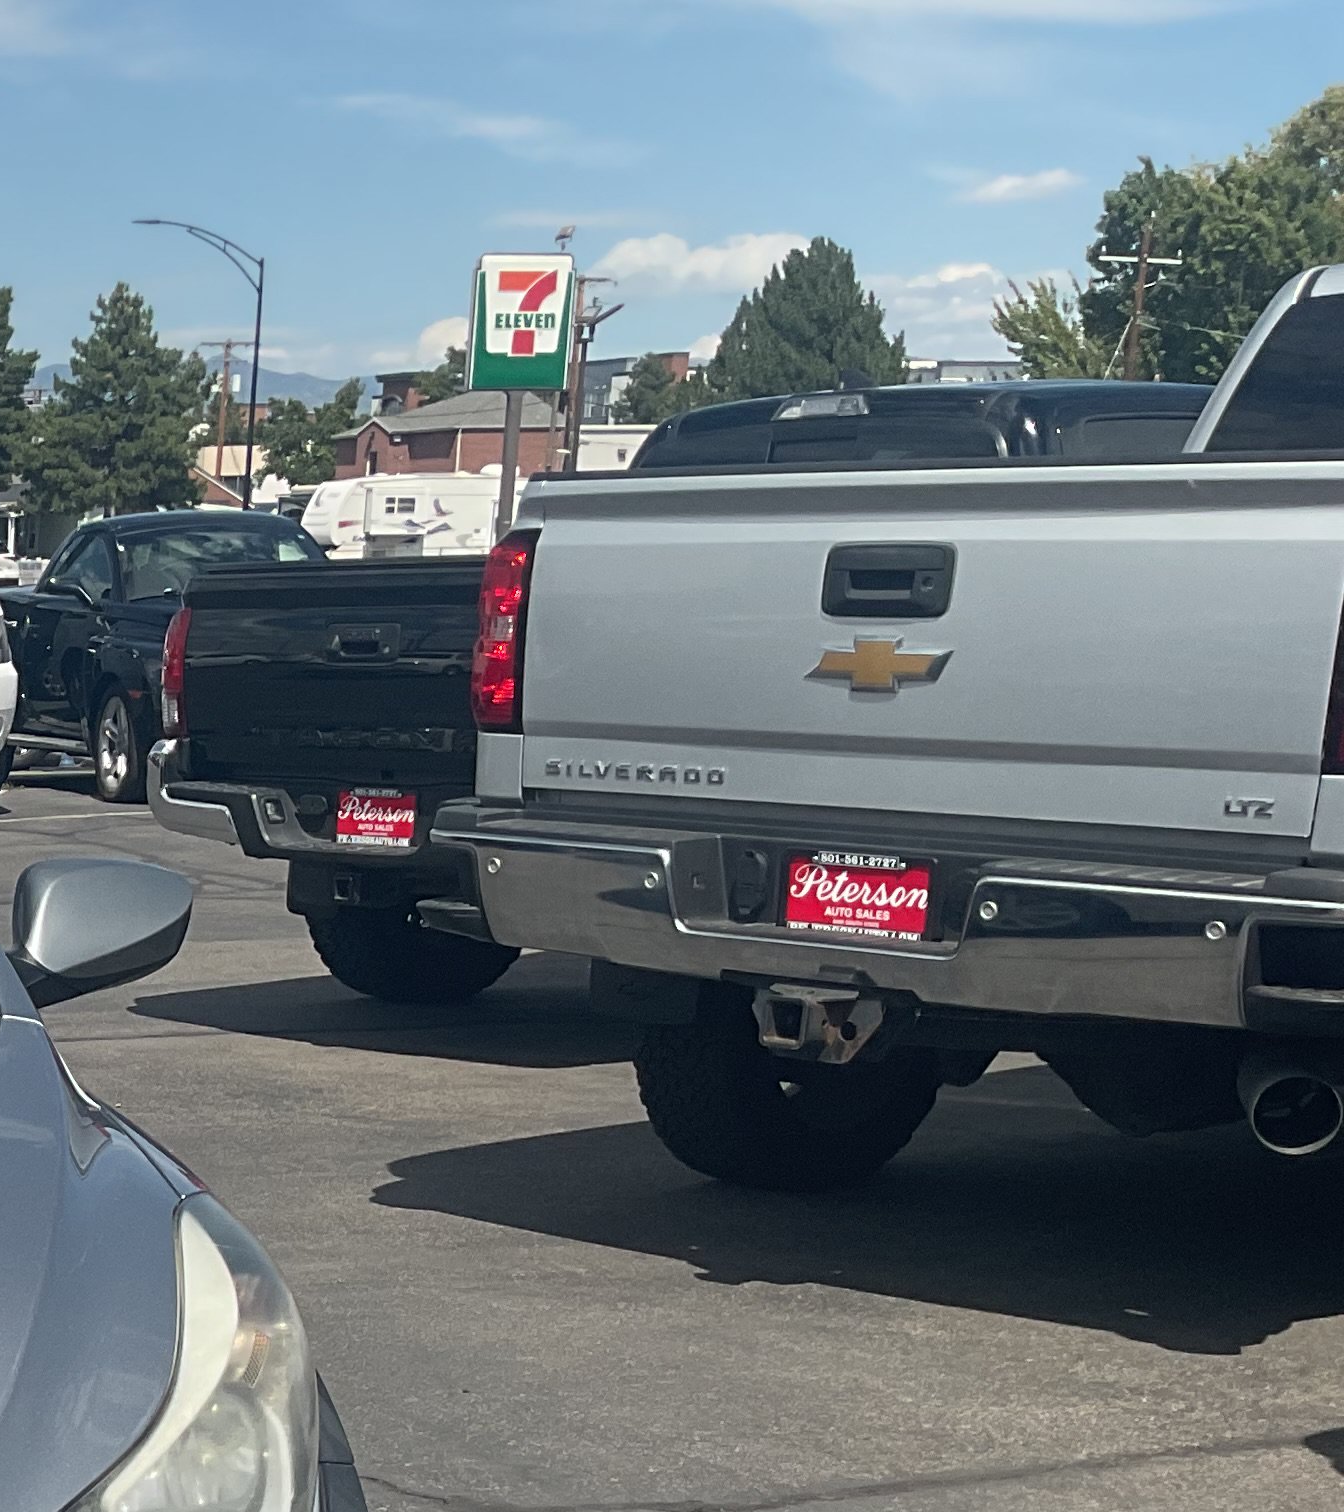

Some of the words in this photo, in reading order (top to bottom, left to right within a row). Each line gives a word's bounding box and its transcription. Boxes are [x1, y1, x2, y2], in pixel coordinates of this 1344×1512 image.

[498, 269, 558, 355] 7
[545, 757, 727, 787] SILVERADO
[338, 795, 415, 823] Peterson
[1223, 795, 1275, 819] LTZ
[820, 852, 897, 869] 801-561-2727
[790, 863, 929, 910] Peterson
[824, 906, 853, 918] AUTO
[855, 908, 891, 921] SALES
